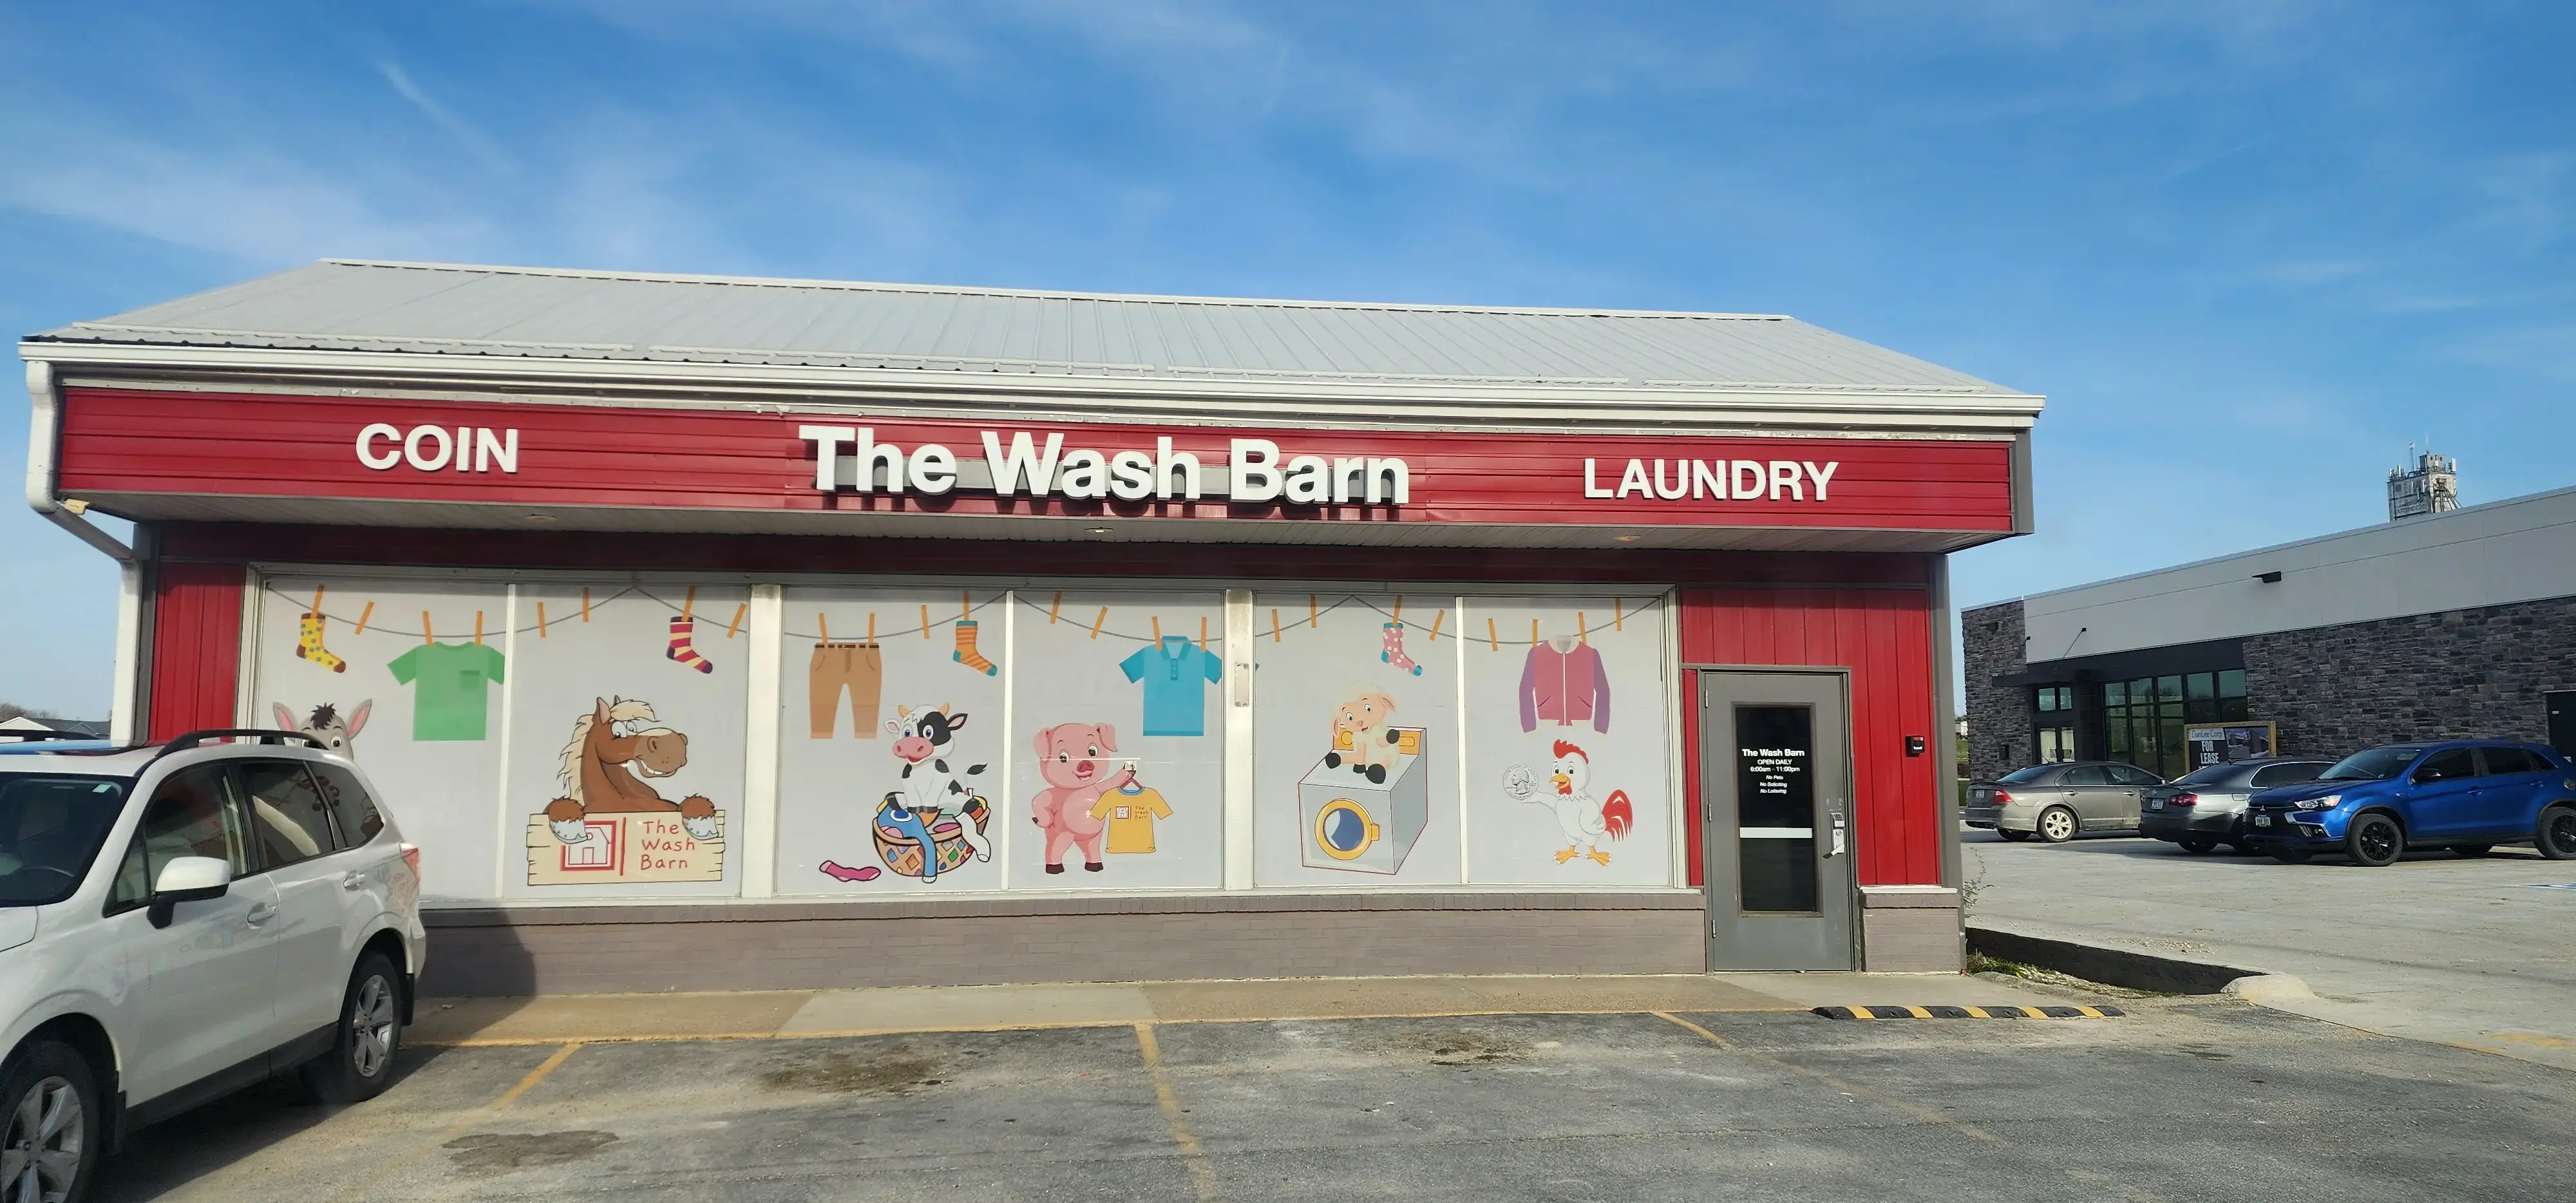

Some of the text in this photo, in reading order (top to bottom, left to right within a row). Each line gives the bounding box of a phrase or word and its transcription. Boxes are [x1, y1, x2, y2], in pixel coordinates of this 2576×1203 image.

[355, 422, 519, 473] COIN
[799, 425, 1409, 505] The Wash Barn
[1584, 457, 1840, 502] LAUNDRY
[2210, 729, 2223, 738] Corp
[1741, 748, 1805, 757] The Wash Barn
[2201, 741, 2214, 752] FOR
[2200, 752, 2220, 764] LEASE
[643, 819, 679, 835] The
[641, 837, 695, 851] Wash
[641, 854, 688, 870] Barn
